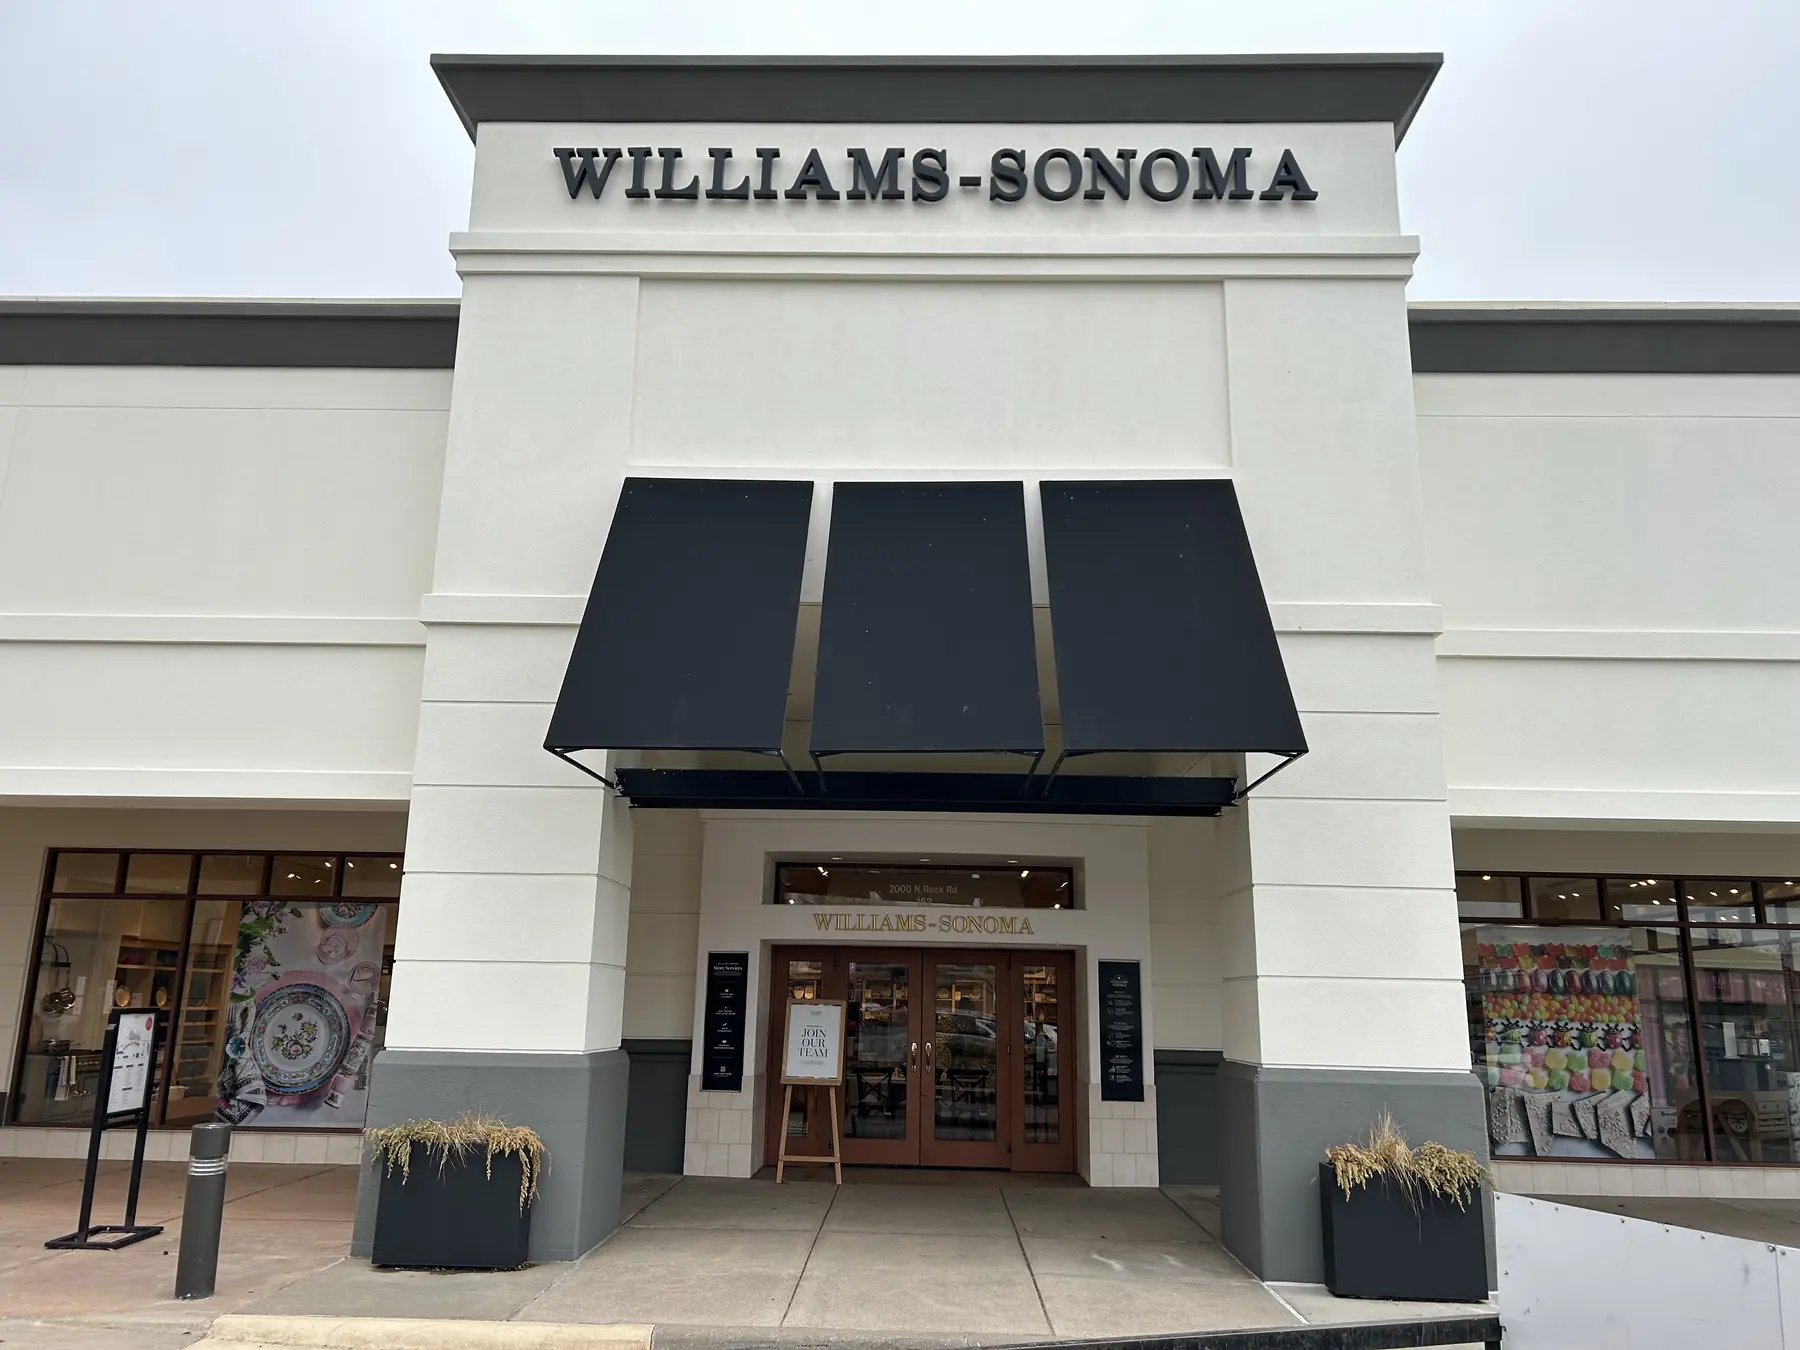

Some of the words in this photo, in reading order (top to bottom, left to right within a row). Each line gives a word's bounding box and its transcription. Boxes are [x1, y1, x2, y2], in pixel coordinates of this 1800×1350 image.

[553, 147, 1319, 202] WILLIAMS-SONOMA
[889, 884, 912, 894] 2000
[923, 885, 944, 894] Rock
[916, 897, 933, 906] 152
[813, 913, 1034, 935] WILLIAMS-SONOMA
[801, 1028, 827, 1038] JOIN
[801, 1038, 826, 1048] OUR
[797, 1047, 828, 1057] TEAM
